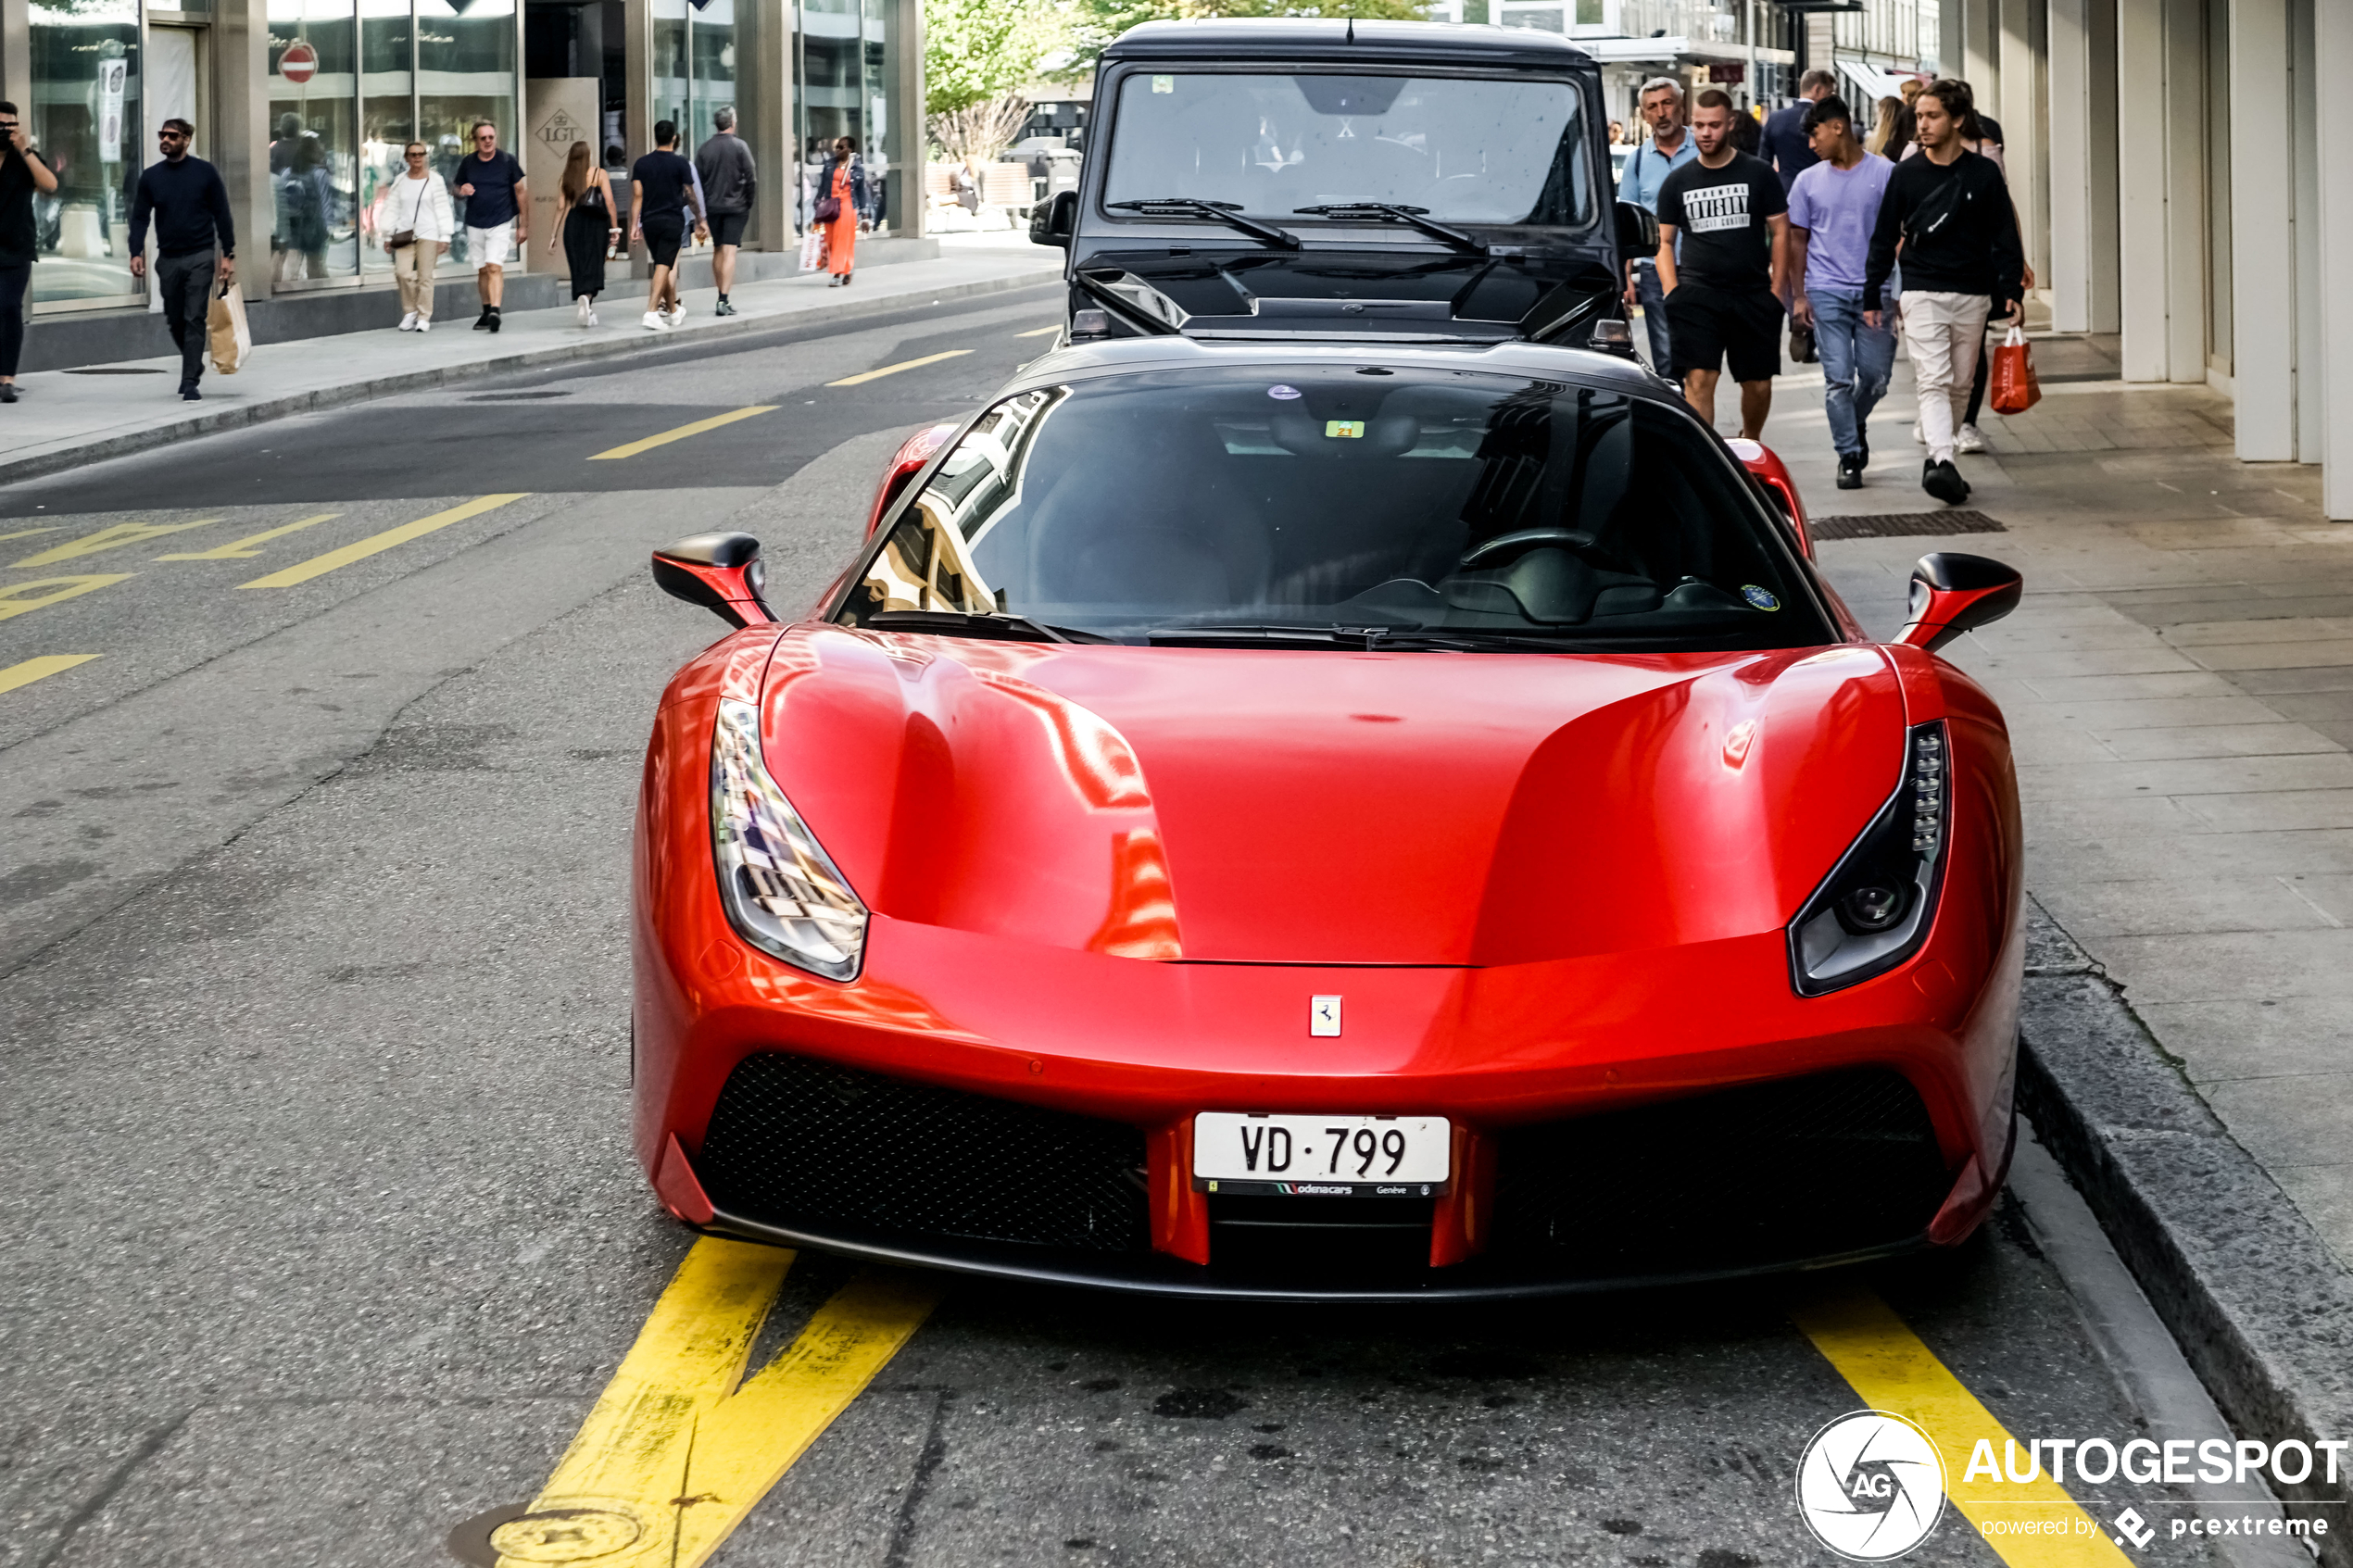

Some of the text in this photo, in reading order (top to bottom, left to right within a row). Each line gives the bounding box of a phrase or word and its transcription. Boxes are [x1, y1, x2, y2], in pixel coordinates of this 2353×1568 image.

[546, 127, 577, 142] LGT
[1686, 186, 1745, 200] PARENTAL
[1338, 427, 1353, 435] 21
[1377, 1185, 1407, 1195] Genève
